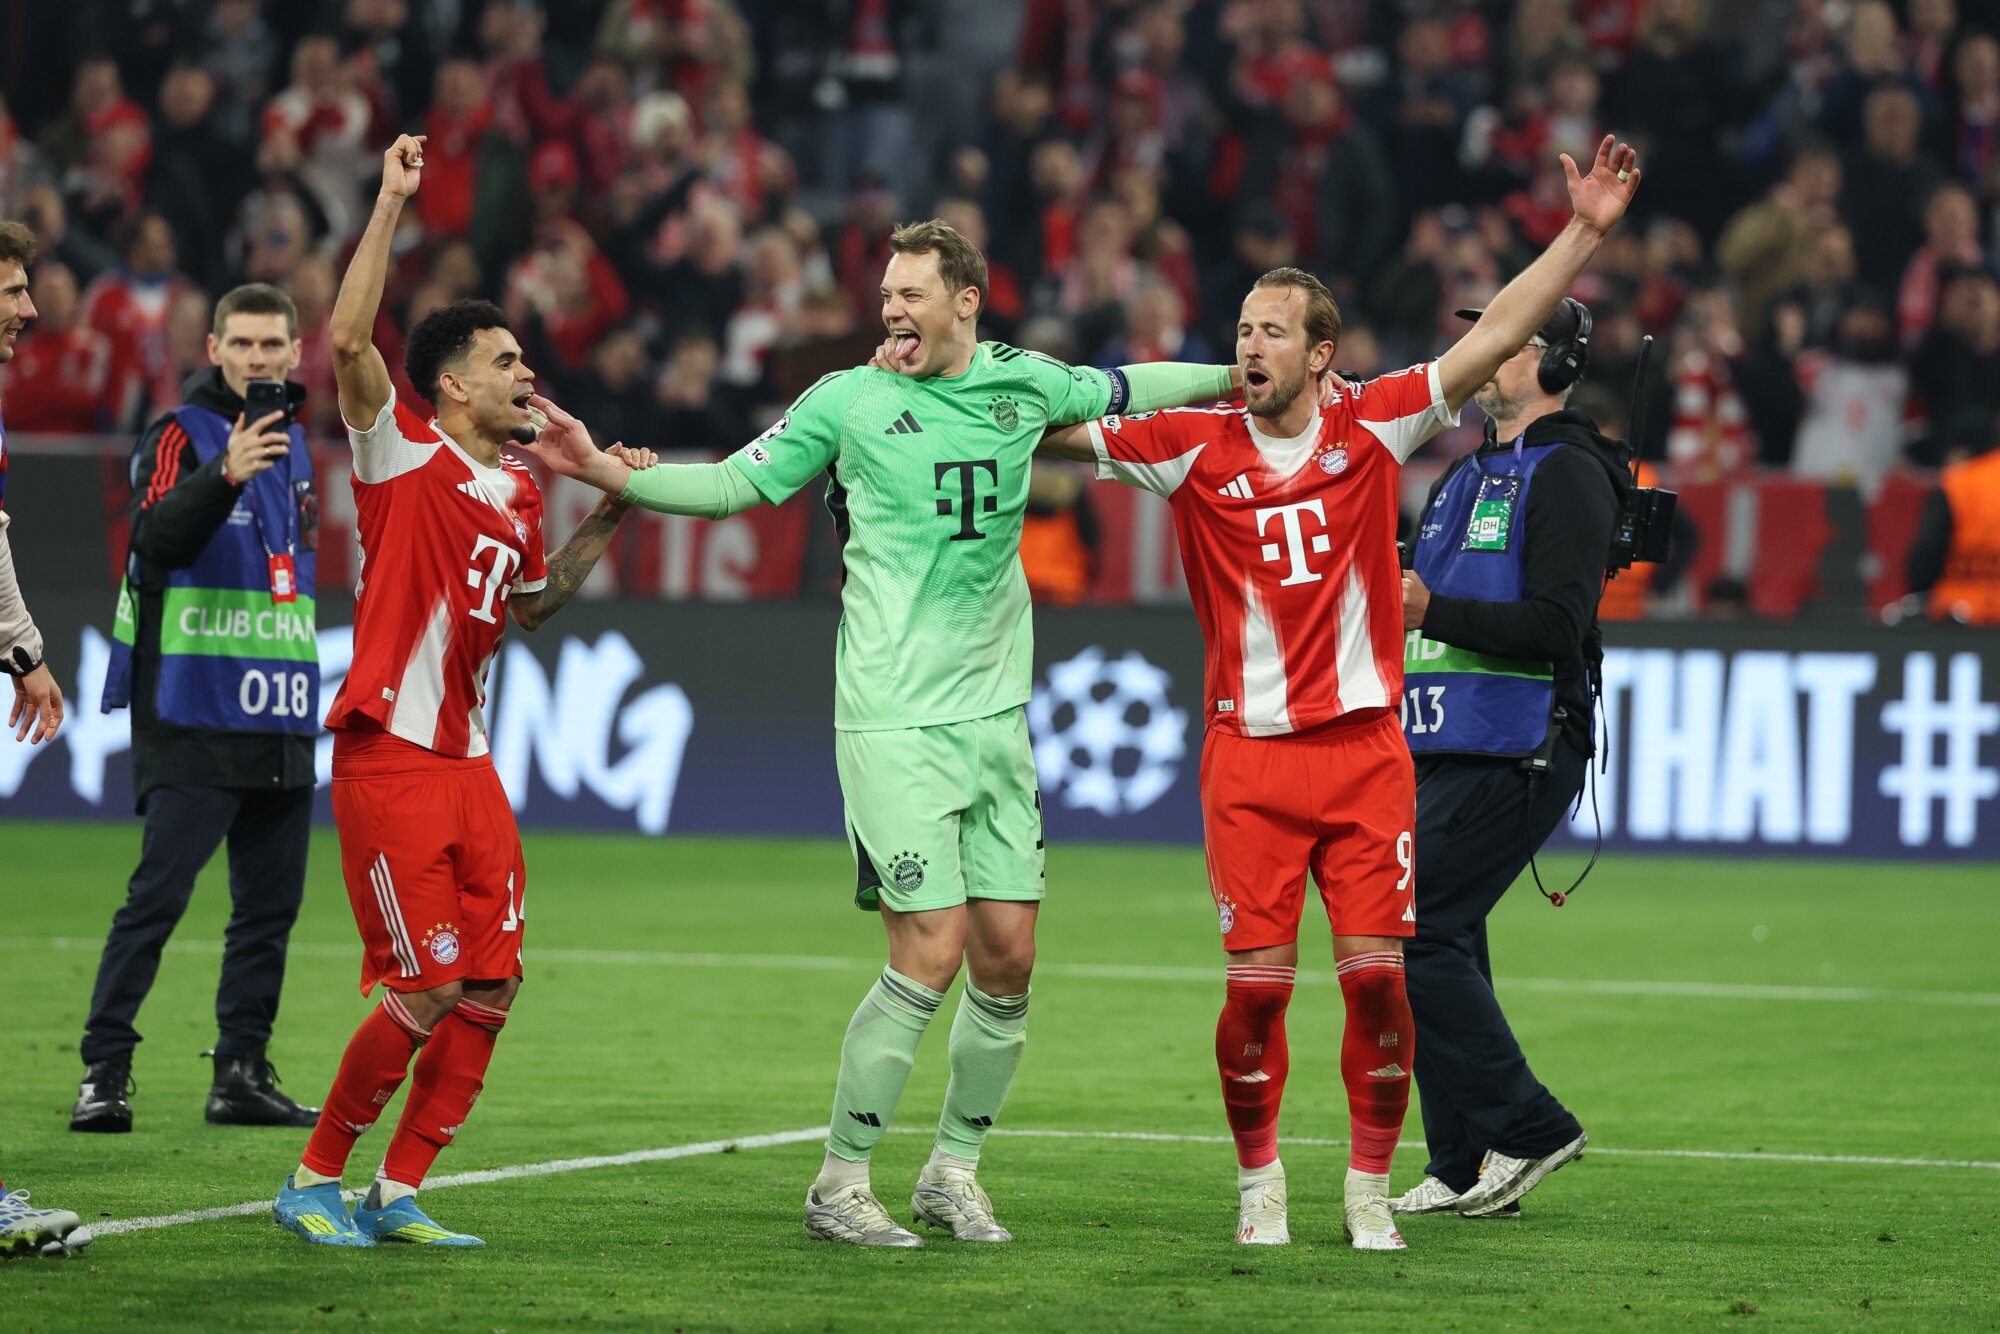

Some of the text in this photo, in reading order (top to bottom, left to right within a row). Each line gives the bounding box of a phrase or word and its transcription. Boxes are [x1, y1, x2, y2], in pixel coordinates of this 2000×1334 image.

[934, 459, 997, 540] T
[1483, 521, 1497, 530] DH
[1255, 498, 1331, 586] T
[467, 533, 521, 625] T
[180, 607, 251, 638] CLUB
[239, 669, 309, 719] 018
[1568, 647, 1879, 844] THAT
[1396, 831, 1412, 891] 9
